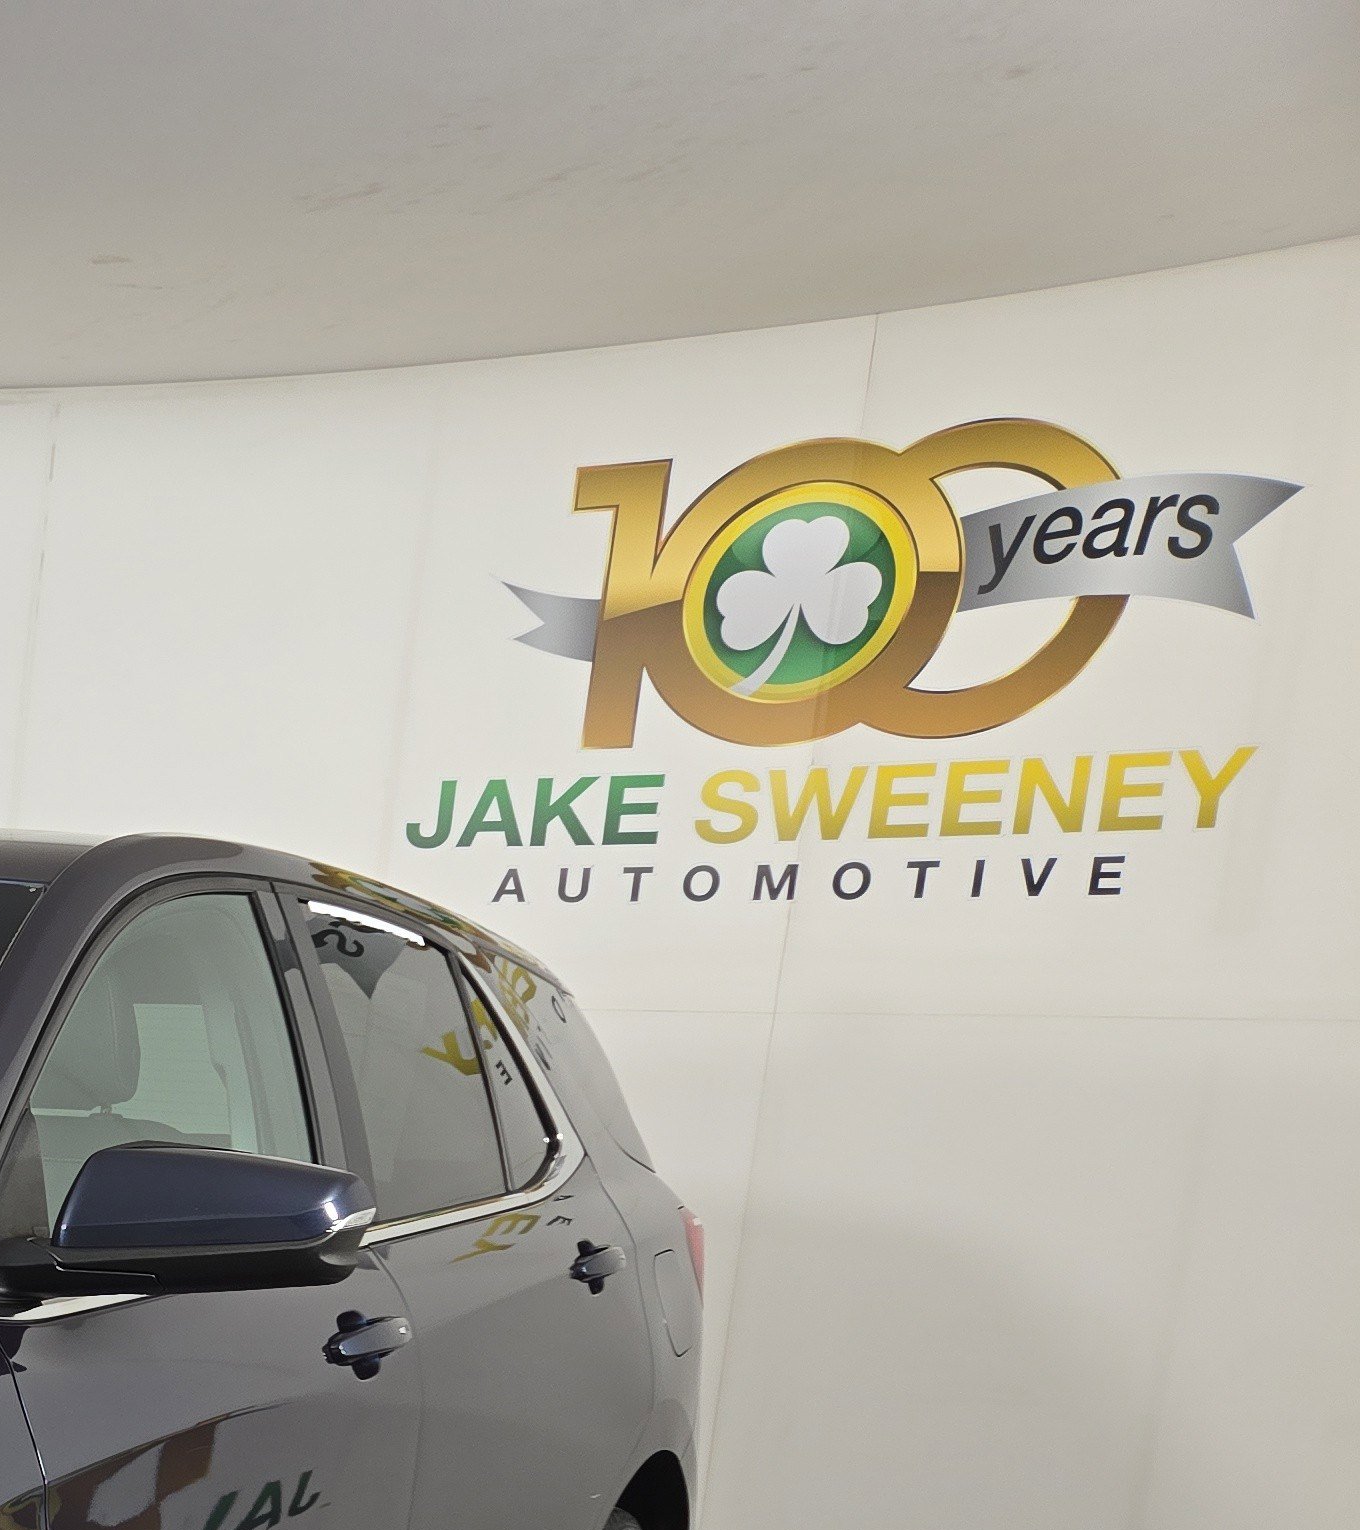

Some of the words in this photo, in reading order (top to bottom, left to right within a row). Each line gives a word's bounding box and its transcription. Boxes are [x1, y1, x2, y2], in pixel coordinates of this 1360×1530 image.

[977, 492, 1220, 595] years
[405, 773, 667, 850] JAKE
[694, 745, 1258, 846] SWEENEY
[492, 855, 1127, 905] AUTOMOTIVE
